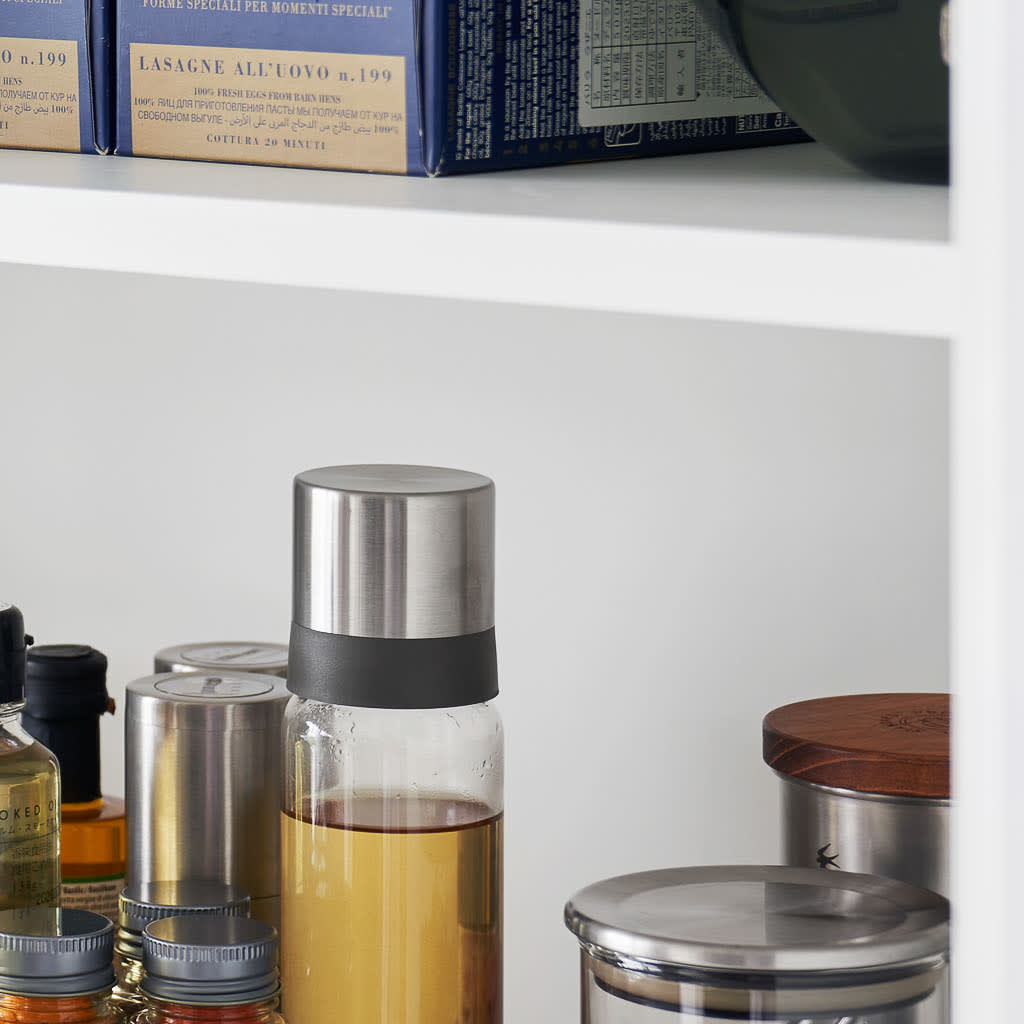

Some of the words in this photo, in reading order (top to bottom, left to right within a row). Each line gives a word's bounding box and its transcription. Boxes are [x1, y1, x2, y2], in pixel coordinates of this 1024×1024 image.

[186, 0, 241, 12] SPECIALI
[244, 1, 268, 13] PER
[271, 2, 328, 16] MOMENTI
[20, 51, 67, 67] n.199
[139, 55, 225, 75] LASAGNE
[338, 67, 392, 83] n.199
[3, 77, 23, 86] HENS
[38, 91, 49, 101] ОТ
[50, 92, 65, 102] КУР
[66, 93, 77, 103] НА
[217, 88, 243, 98] FRESH
[245, 89, 266, 98] EGGS
[268, 91, 292, 101] FROM
[294, 93, 317, 102] BARN
[319, 94, 341, 104] HENS
[137, 110, 190, 122] СВОБОДНОМ
[191, 113, 223, 124] ВЫГУЛЕ
[176, 98, 193, 109] ДЛЯ
[194, 100, 264, 112] ПРИГОТОВЛЕНИЯ
[266, 104, 295, 115] ПАСТЫ
[296, 106, 310, 116] МЫ
[312, 107, 358, 119] ПОЛУЧАЕМ
[359, 109, 371, 120] ОТ
[373, 110, 389, 121] КУР
[391, 112, 402, 122] НА
[206, 134, 260, 145] COTTURA
[264, 138, 278, 147] 20
[283, 139, 326, 150] MINUTI
